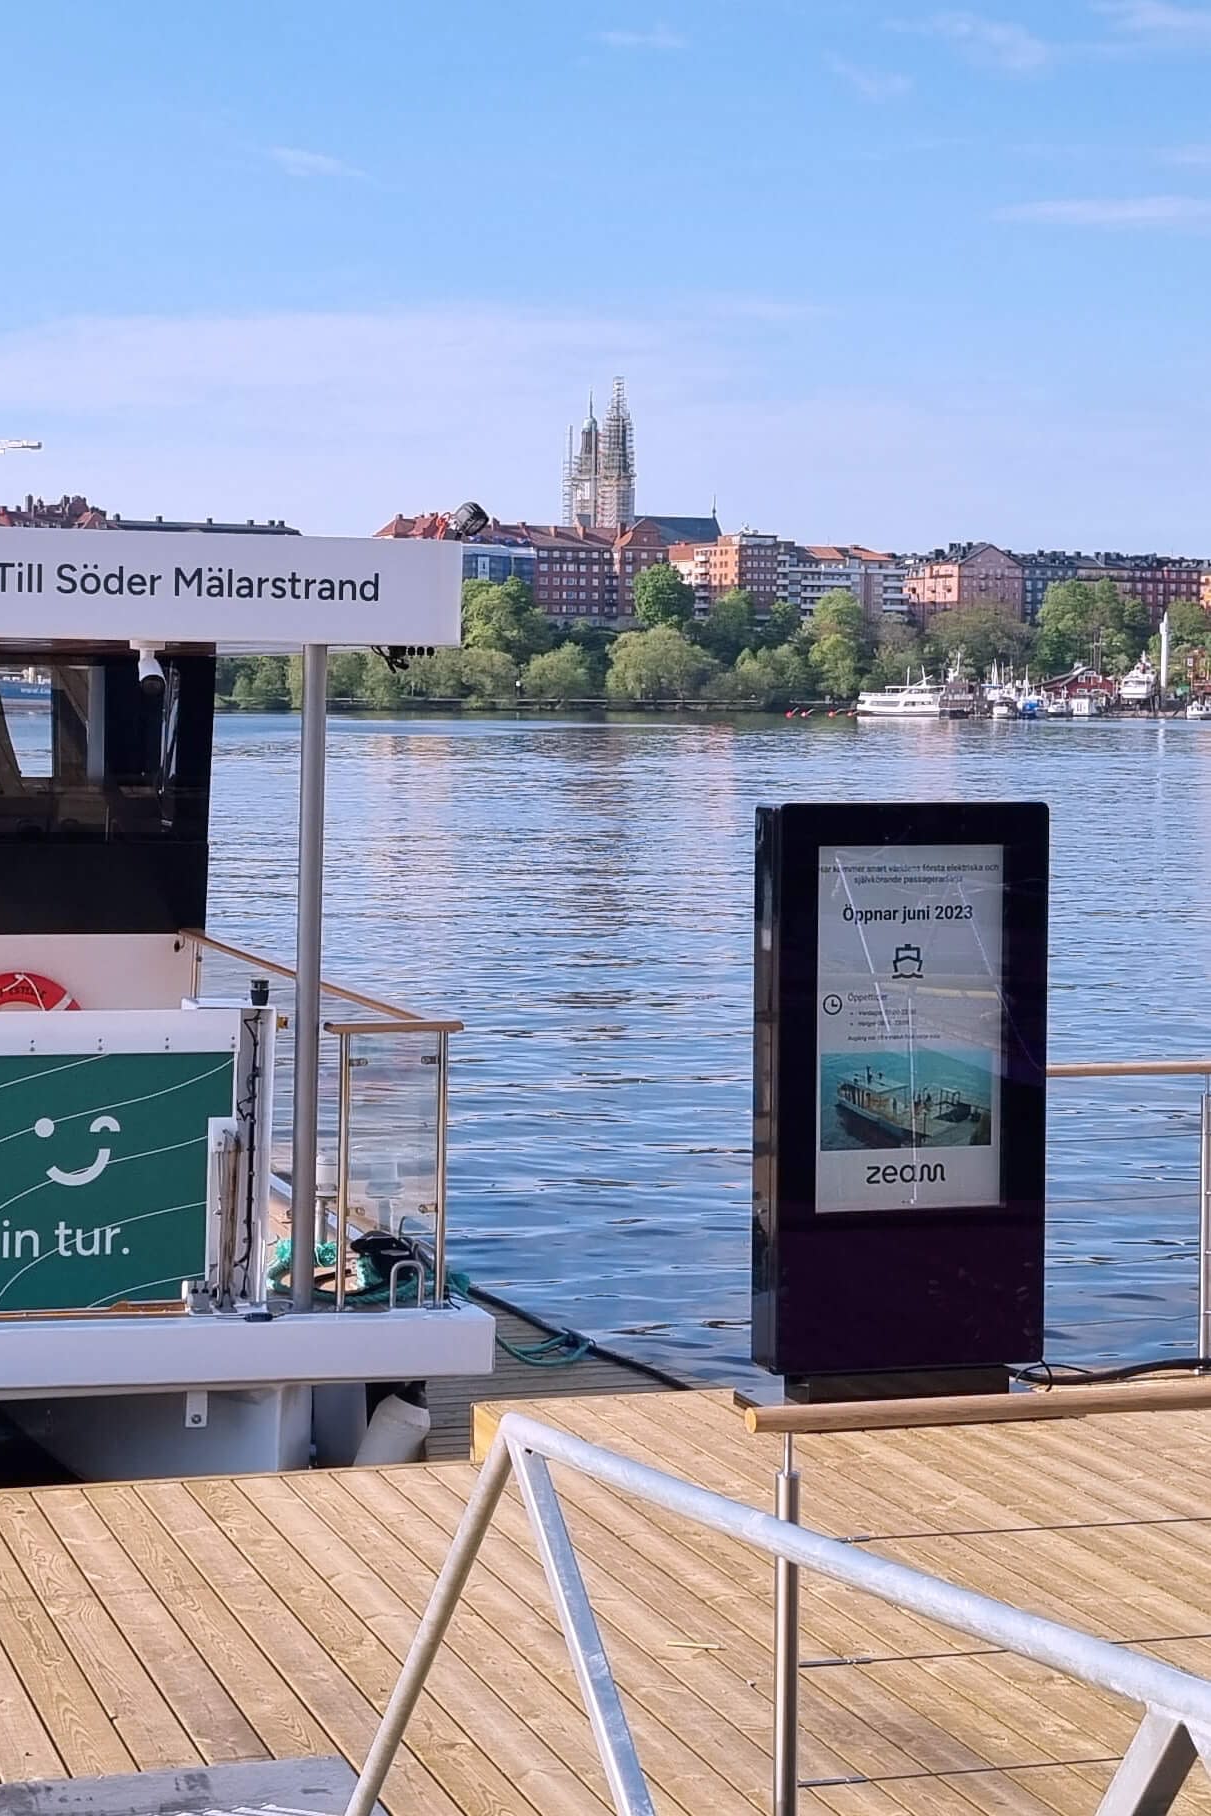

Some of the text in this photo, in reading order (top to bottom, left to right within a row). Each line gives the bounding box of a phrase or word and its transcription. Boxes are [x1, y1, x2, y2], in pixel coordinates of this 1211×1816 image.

[56, 563, 162, 596] Söder
[174, 567, 380, 602] Mälarstrand
[985, 863, 1000, 872] och
[842, 903, 973, 925] Öppnar juni 2023
[866, 1163, 946, 1185] zeam
[54, 1221, 129, 1257] tur.
